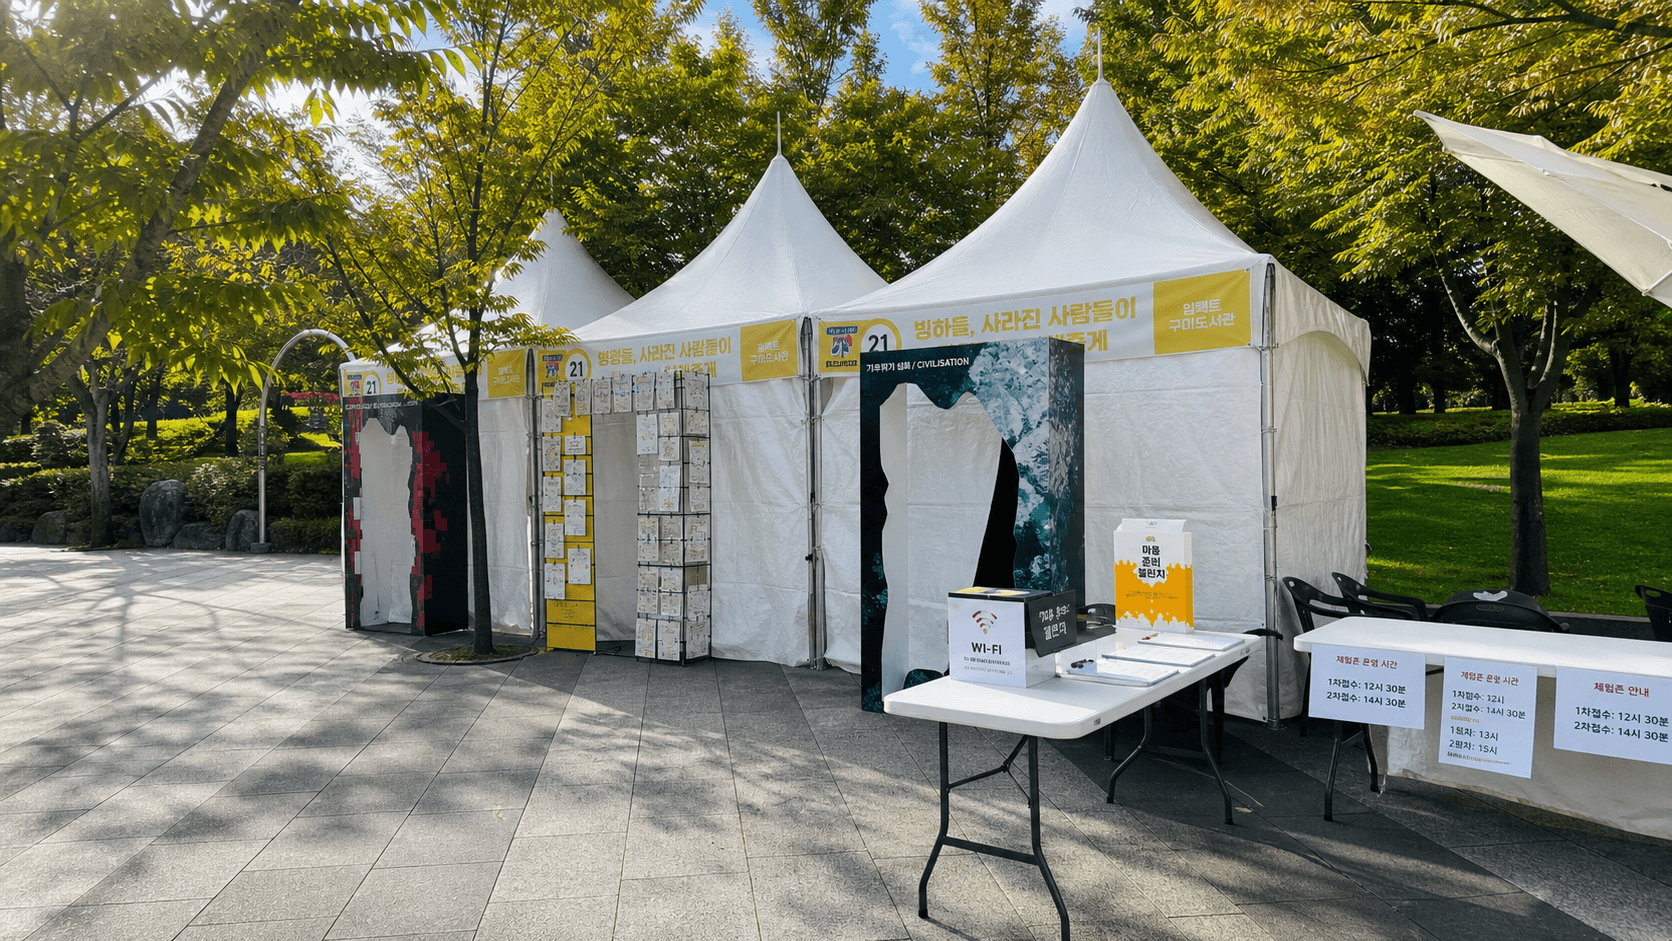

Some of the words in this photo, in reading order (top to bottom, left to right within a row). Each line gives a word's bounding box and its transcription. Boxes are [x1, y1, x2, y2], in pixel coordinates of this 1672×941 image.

[914, 315, 975, 340] 빙하들,
[981, 308, 1040, 333] 사라진
[1048, 296, 1136, 327] 사람들이
[1169, 312, 1235, 332] 구미도서관
[640, 343, 675, 362] 사라진
[679, 336, 731, 358] 사람들이
[868, 334, 888, 352] 21
[570, 361, 583, 377] 21
[917, 357, 970, 368] CIVILISATION
[367, 380, 376, 394] 21
[971, 641, 1002, 655] WI-FI
[1381, 660, 1398, 669] 시간
[1328, 678, 1361, 689] 1차접수:
[1364, 682, 1383, 691] 12시
[1386, 684, 1406, 694] 30분
[1503, 676, 1519, 686] 시간
[1487, 694, 1505, 704] 12시
[1628, 686, 1650, 698] 안내
[1364, 696, 1383, 705] 14시
[1385, 698, 1406, 708] 30분
[1486, 706, 1504, 716] 14시
[1506, 709, 1526, 720] 30분
[1576, 707, 1614, 720] 1차접수:
[1618, 712, 1641, 723] 12시
[1644, 715, 1669, 727] 30분
[1479, 730, 1499, 741] 13시
[1574, 721, 1614, 734] 2차접수:
[1618, 728, 1641, 739] 14시
[1644, 731, 1669, 743] 30분
[1478, 744, 1498, 755] 15시
